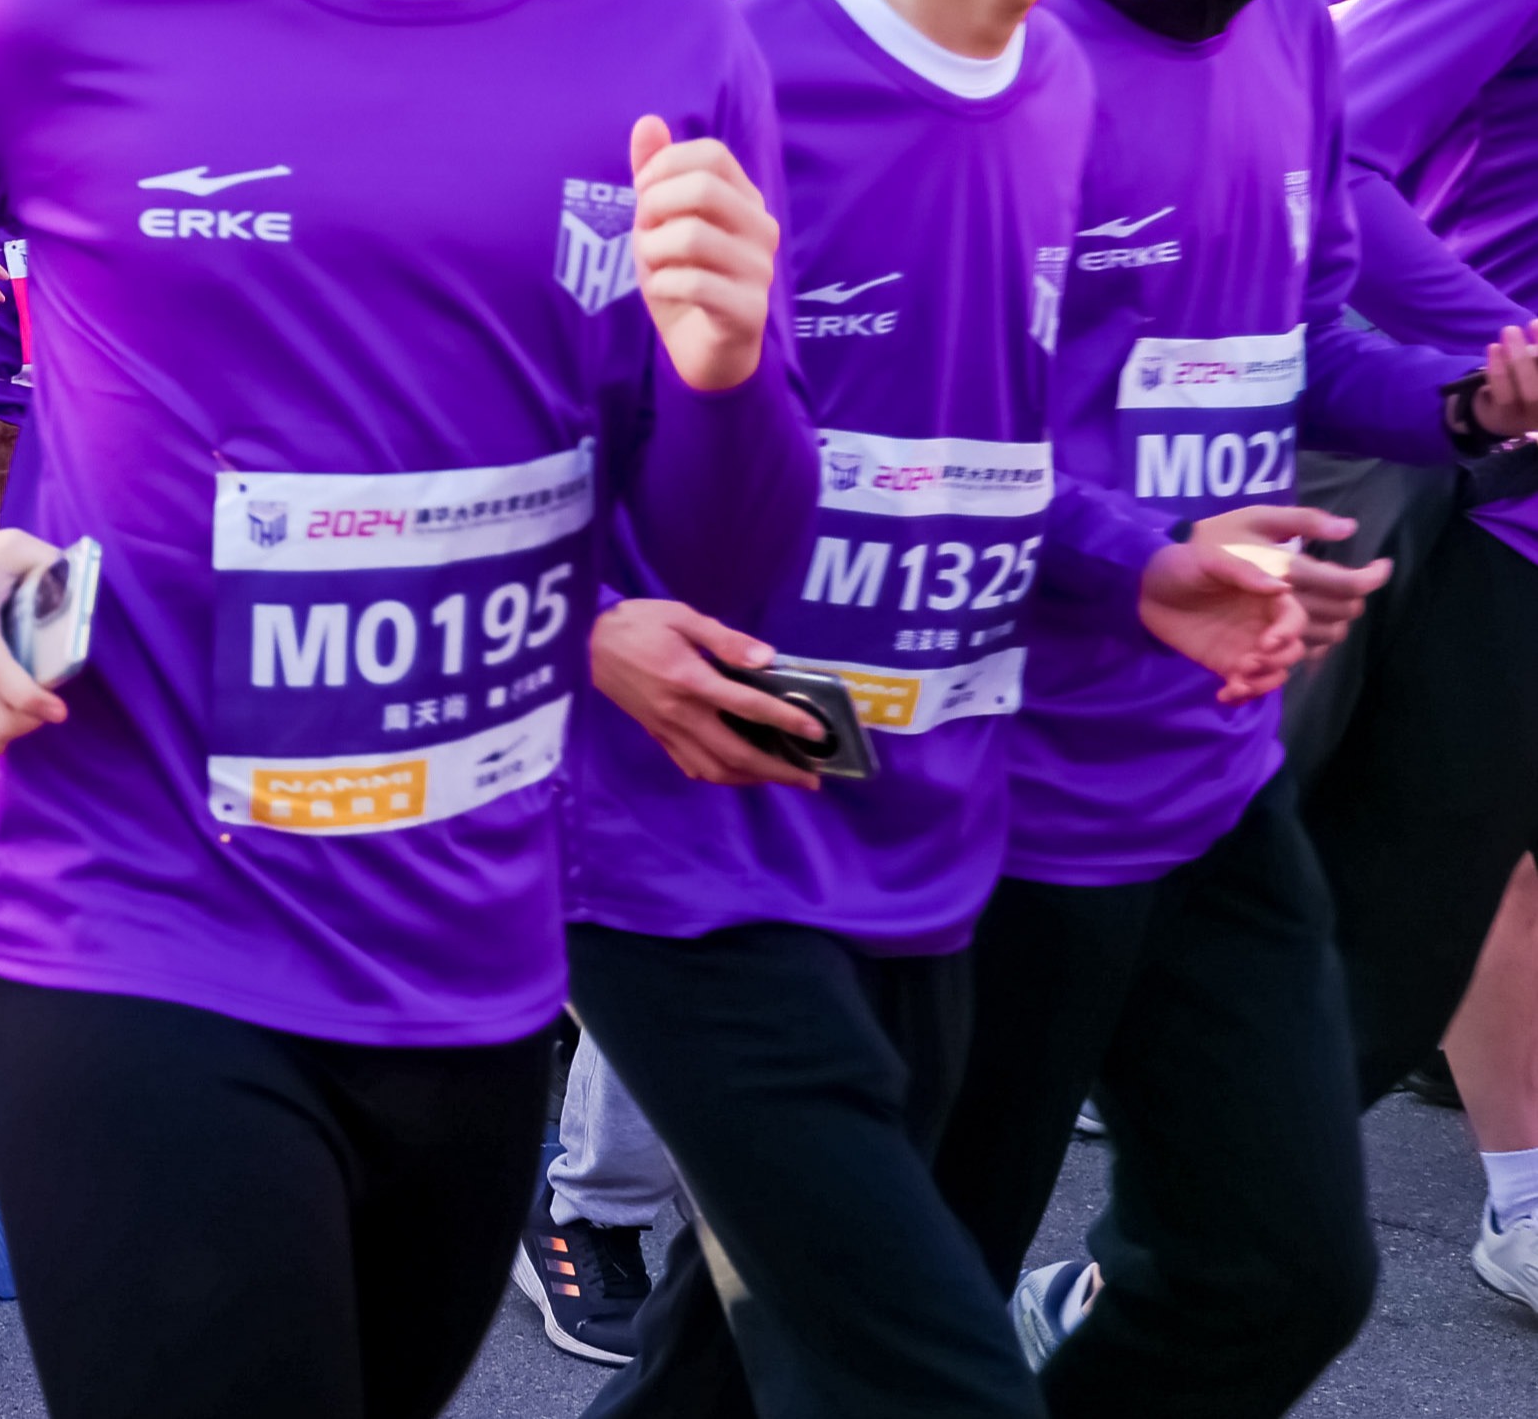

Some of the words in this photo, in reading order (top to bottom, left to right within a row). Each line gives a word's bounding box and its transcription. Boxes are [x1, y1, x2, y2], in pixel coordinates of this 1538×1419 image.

[563, 178, 637, 207] 202
[138, 208, 292, 242] ERKE
[1076, 241, 1181, 272] ERKE
[306, 508, 407, 539] 2024
[800, 533, 1044, 612] M1325
[251, 562, 574, 688] M0195
